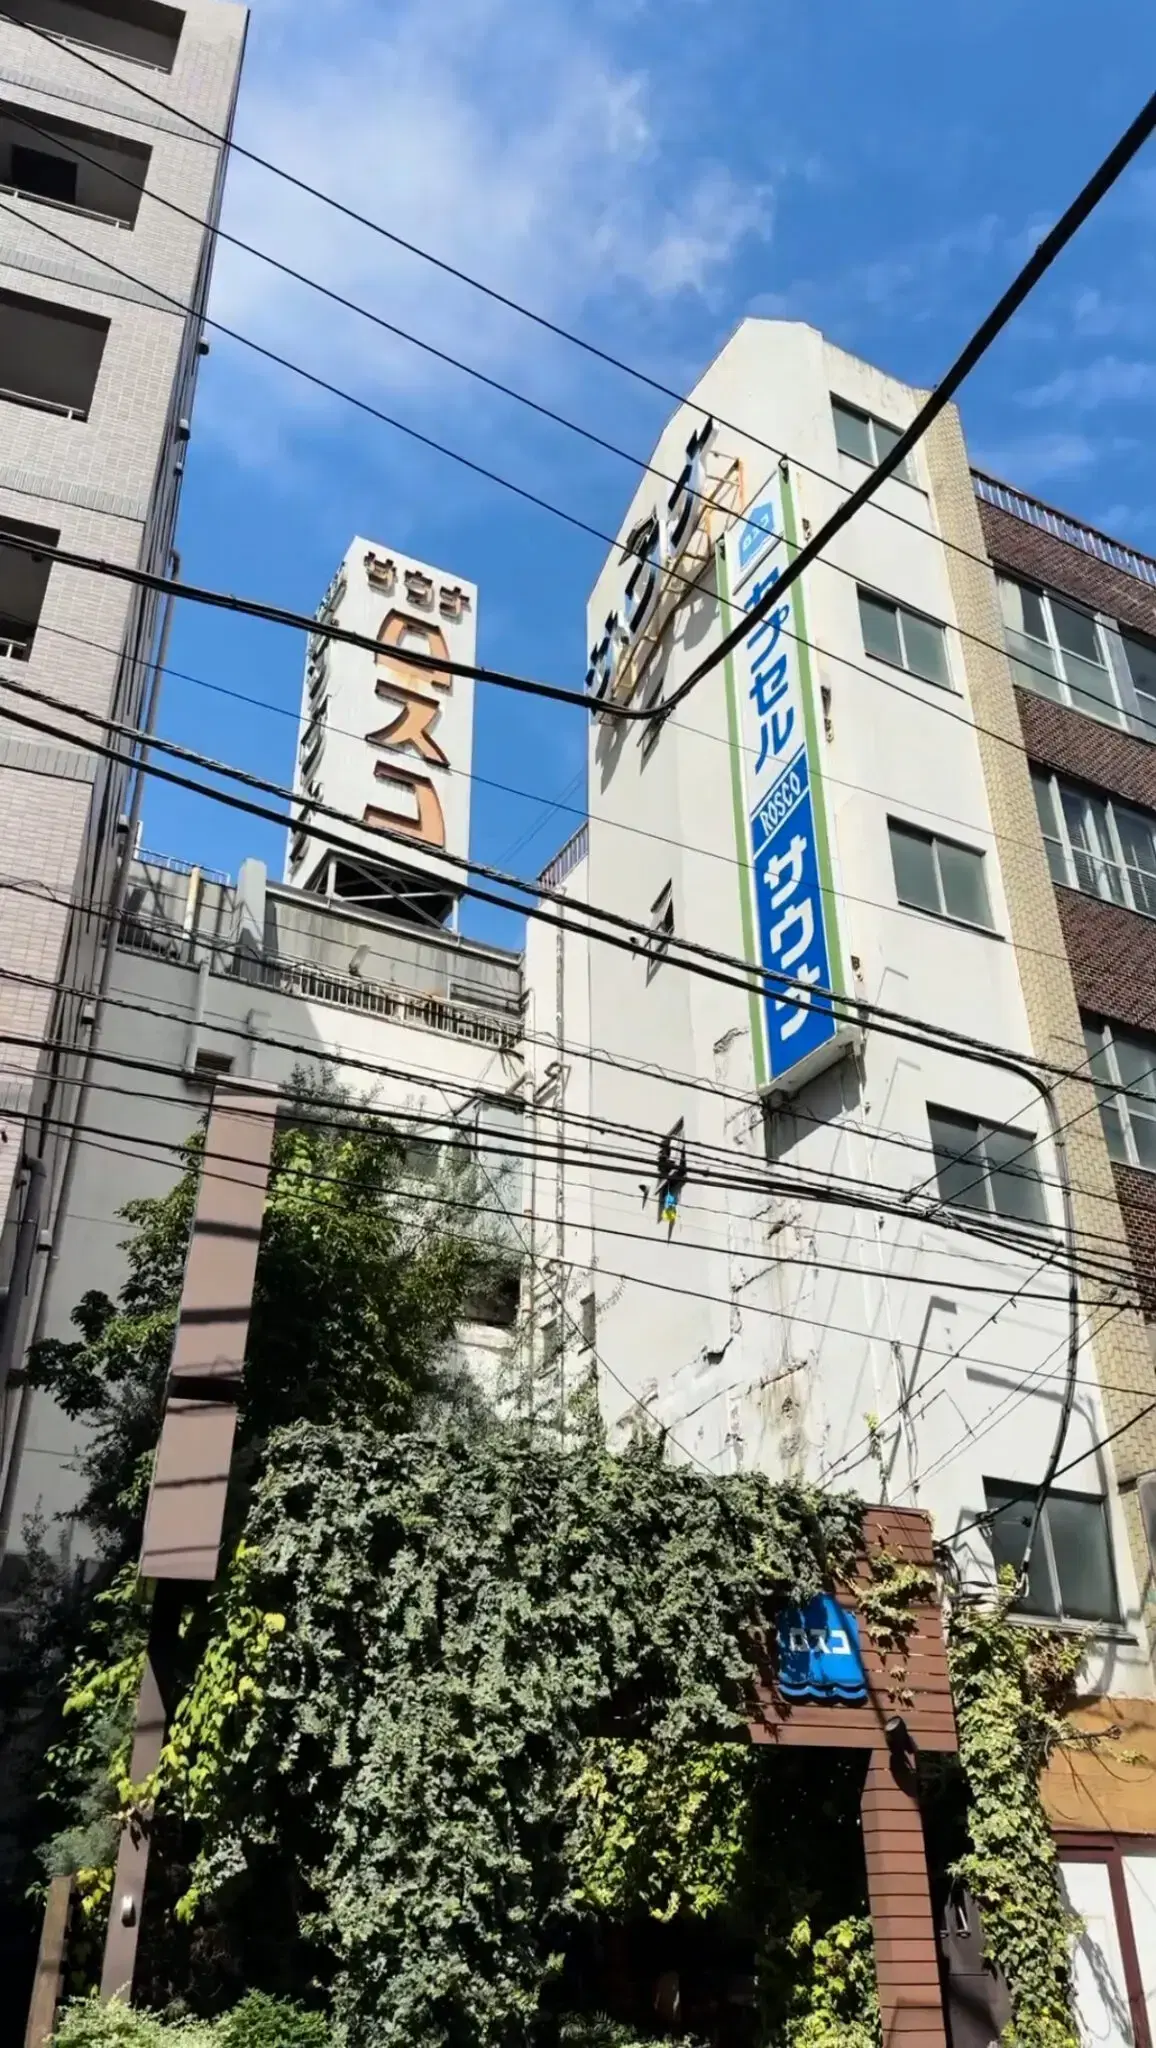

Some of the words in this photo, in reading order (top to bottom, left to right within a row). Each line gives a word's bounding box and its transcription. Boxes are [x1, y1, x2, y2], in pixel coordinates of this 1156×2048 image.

[363, 551, 470, 617] サウナ
[365, 608, 453, 848] ロスコ
[760, 771, 800, 836] ROSCO
[763, 834, 820, 1040] サウナ
